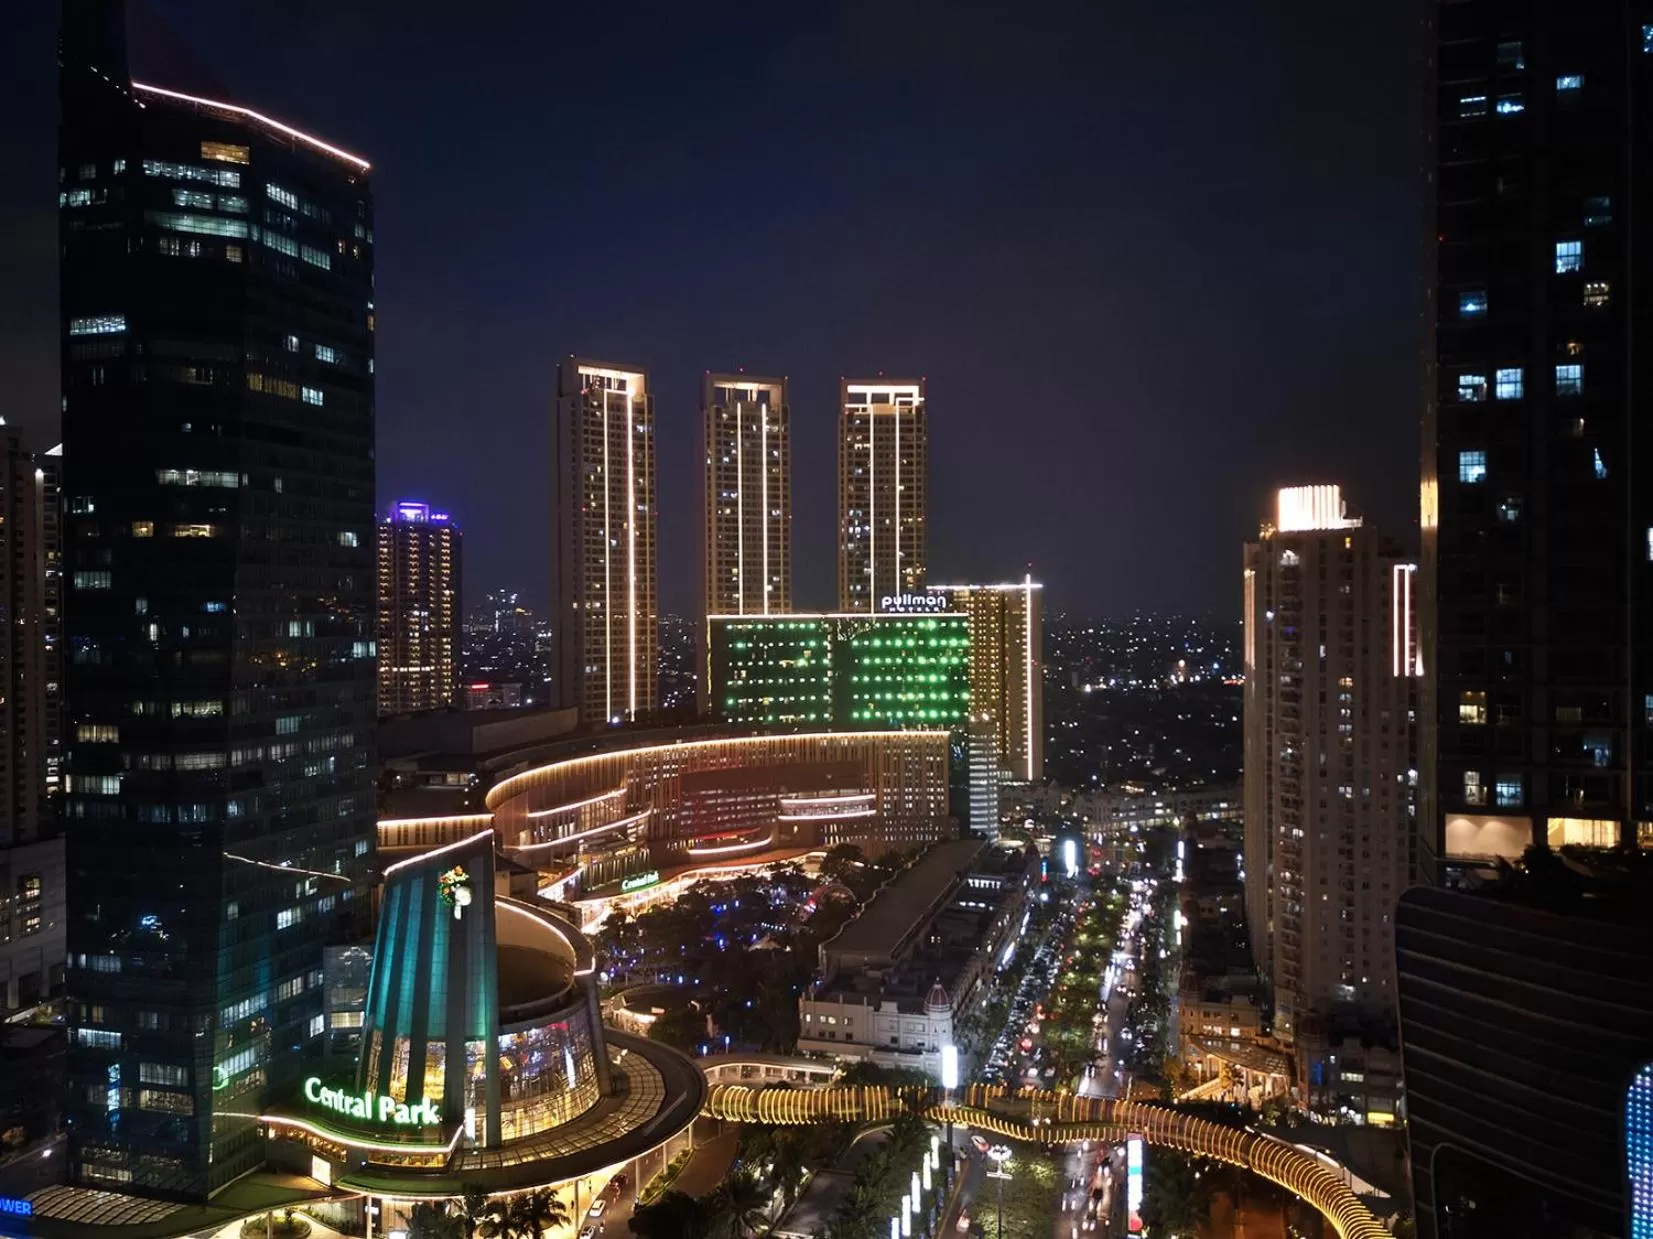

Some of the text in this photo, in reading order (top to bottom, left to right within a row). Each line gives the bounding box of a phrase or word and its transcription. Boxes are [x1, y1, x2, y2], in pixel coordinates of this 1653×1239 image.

[881, 593, 947, 609] pullman
[304, 1076, 440, 1125] Central Park
[0, 1198, 32, 1216] WER
